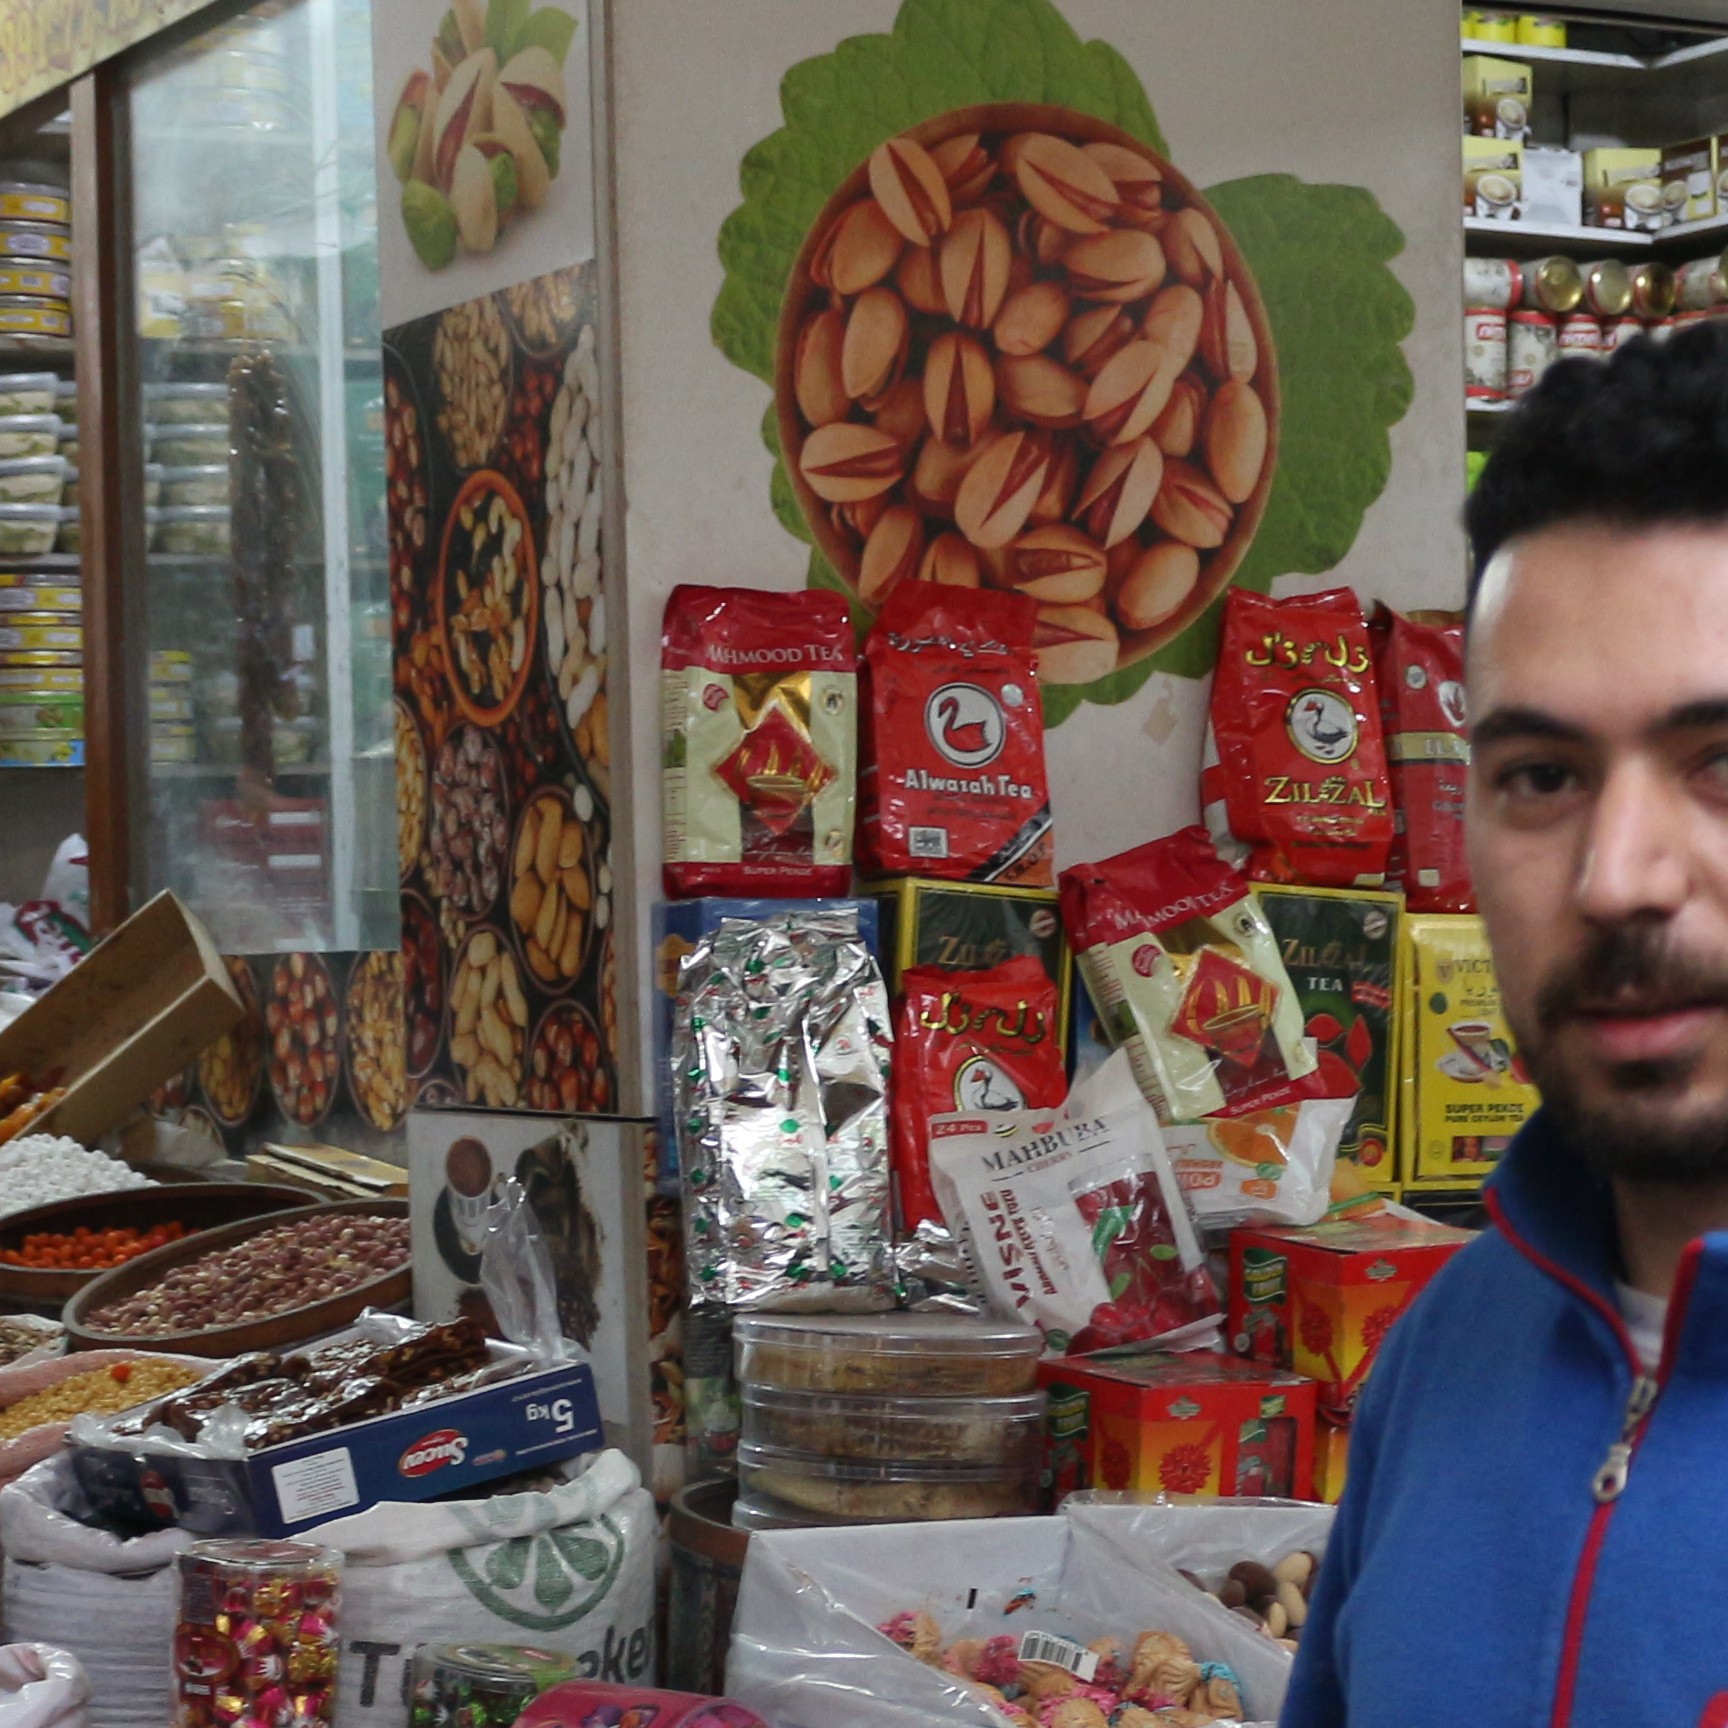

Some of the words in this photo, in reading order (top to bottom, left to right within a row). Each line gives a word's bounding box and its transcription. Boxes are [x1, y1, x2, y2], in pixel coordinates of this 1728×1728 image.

[903, 768, 995, 798] Alwazah
[997, 774, 1034, 799] Tea
[1455, 958, 1493, 975] VICT
[1307, 976, 1344, 992] TEA
[935, 1123, 957, 1136] 24
[980, 1115, 1110, 1172] MAHBUBA
[525, 1402, 552, 1422] kg
[551, 1398, 575, 1434] 5
